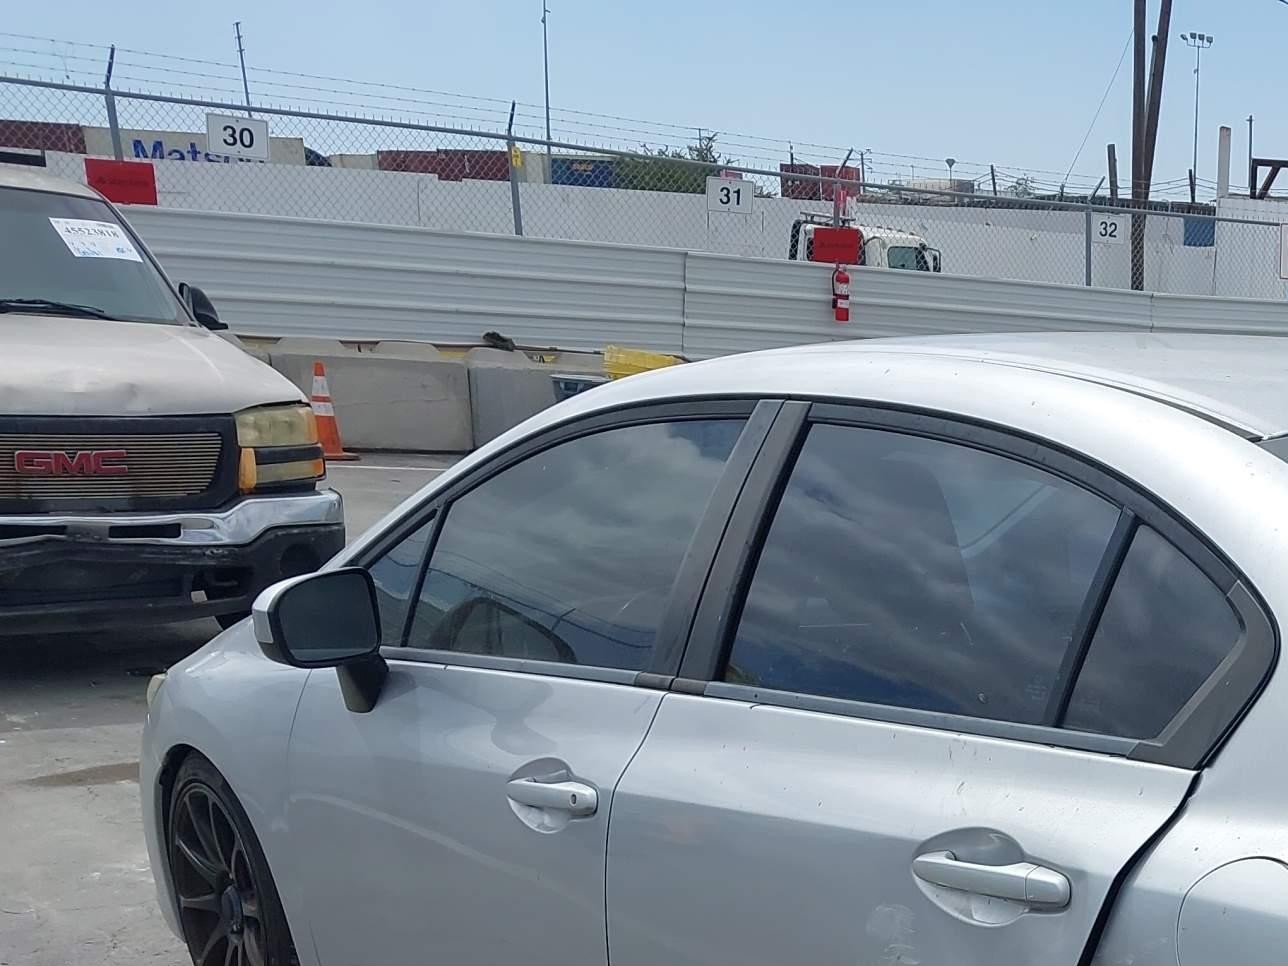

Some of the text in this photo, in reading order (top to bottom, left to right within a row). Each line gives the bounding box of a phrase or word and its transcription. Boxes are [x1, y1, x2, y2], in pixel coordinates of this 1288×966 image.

[222, 125, 254, 148] 30
[719, 186, 741, 206] 31
[1099, 221, 1118, 238] 32
[15, 449, 128, 475] GMC
